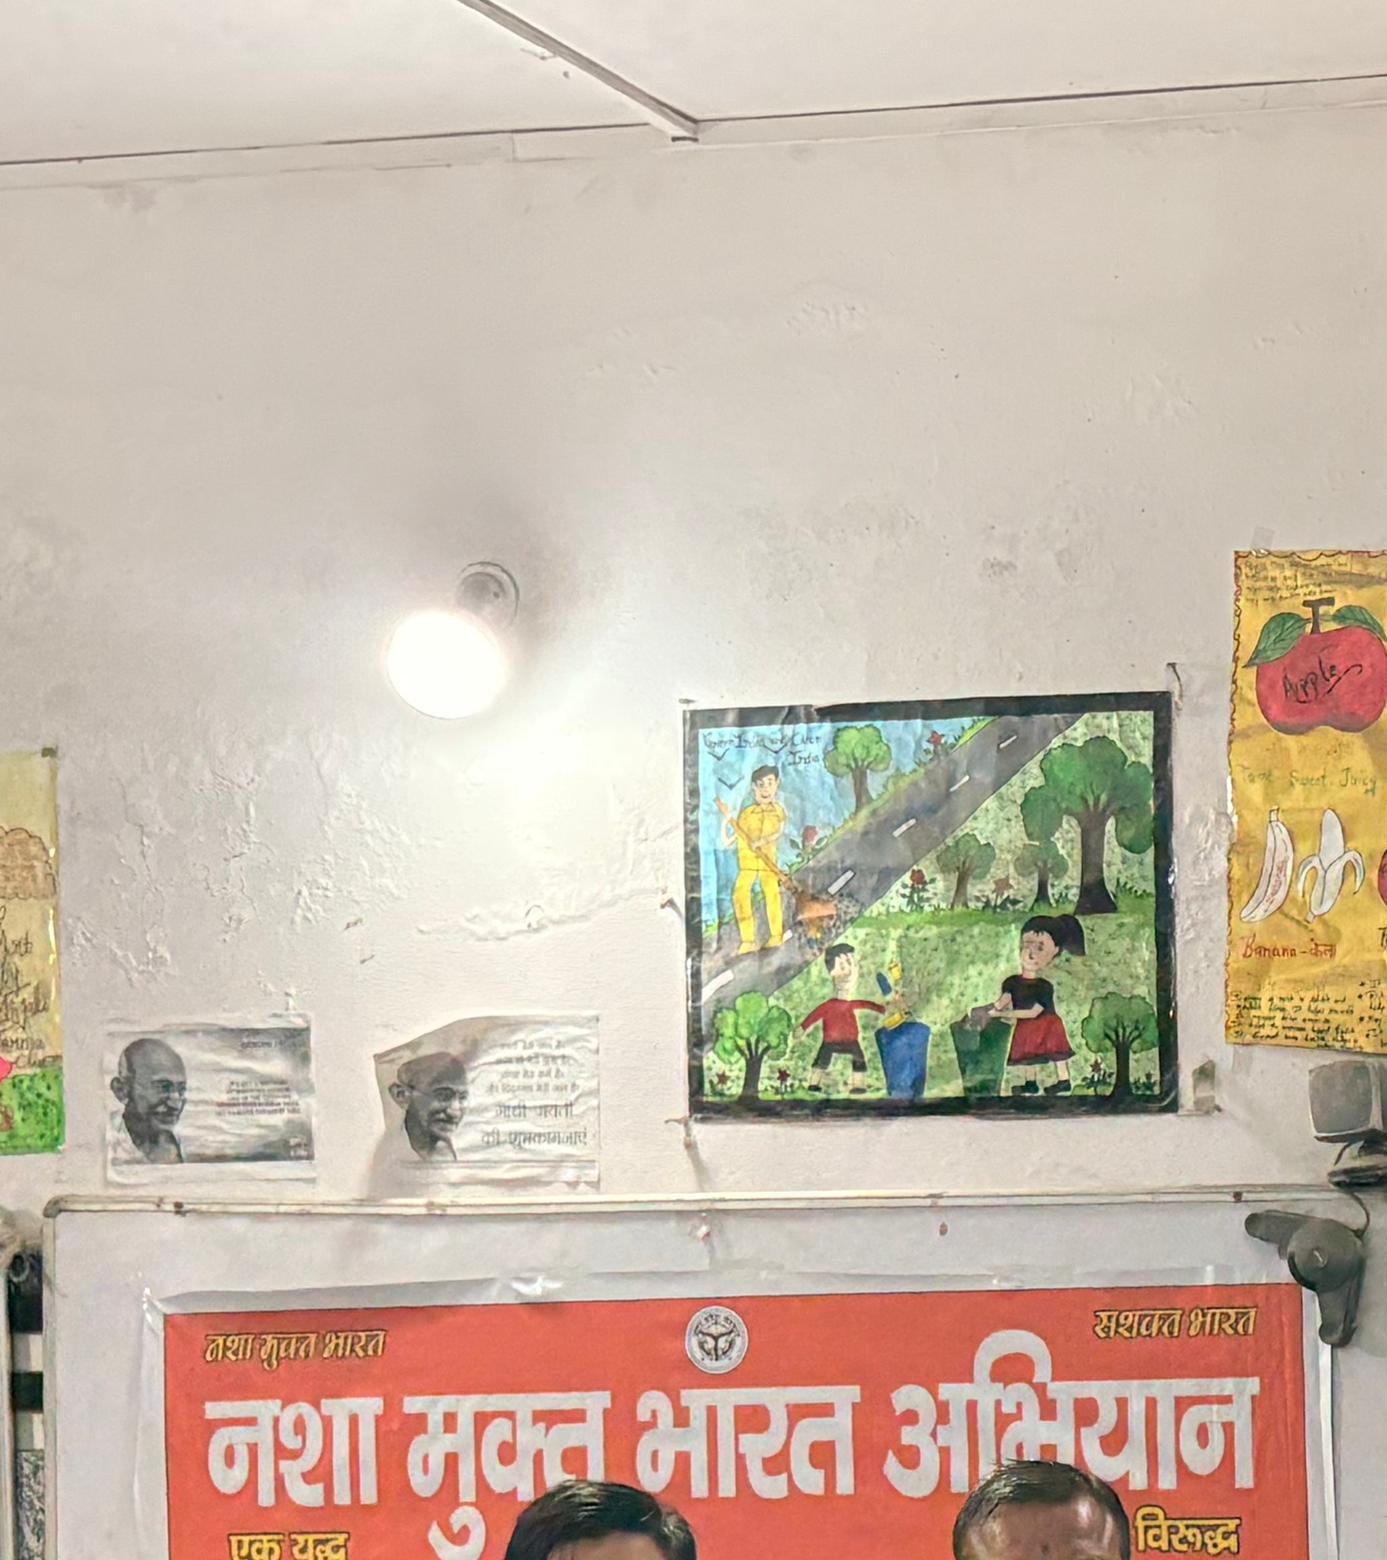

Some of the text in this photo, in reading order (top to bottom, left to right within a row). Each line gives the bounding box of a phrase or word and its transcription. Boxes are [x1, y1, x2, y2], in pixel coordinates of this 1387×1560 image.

[1282, 655, 1347, 704] Apple
[1093, 1305, 1259, 1339] सशक्त भारत
[203, 1325, 387, 1371] नशा मुक्त भारत
[203, 1396, 384, 1508] नशा
[636, 1384, 862, 1500] भारत
[883, 1329, 1261, 1499] अभियान
